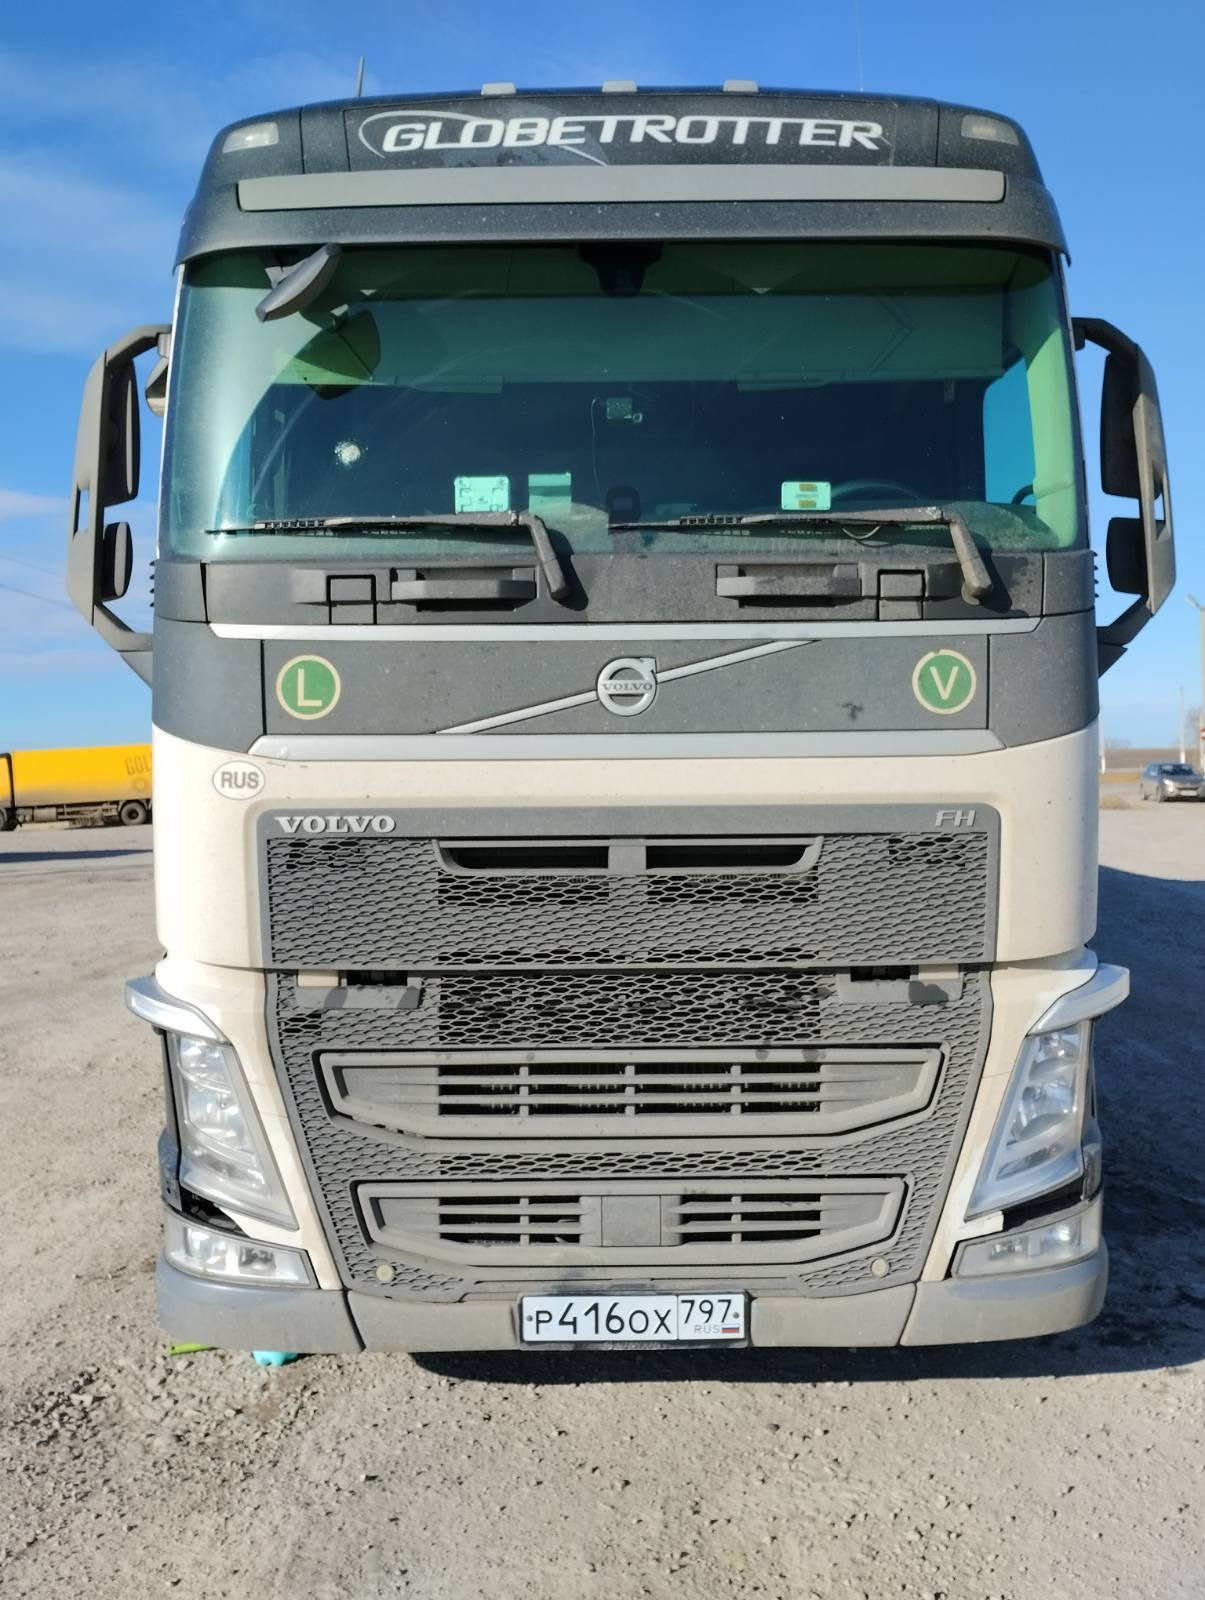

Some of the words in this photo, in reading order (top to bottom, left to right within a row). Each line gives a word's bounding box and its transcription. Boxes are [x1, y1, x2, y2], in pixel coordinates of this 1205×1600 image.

[382, 115, 883, 153] GLOBETROTTER
[297, 668, 323, 707] L
[601, 682, 653, 691] VOLVO
[929, 666, 958, 700] V
[220, 771, 259, 789] RUS
[275, 815, 396, 833] VOLVO
[934, 809, 976, 827] FH
[681, 1299, 732, 1324] 797
[694, 1325, 720, 1333] RUS
